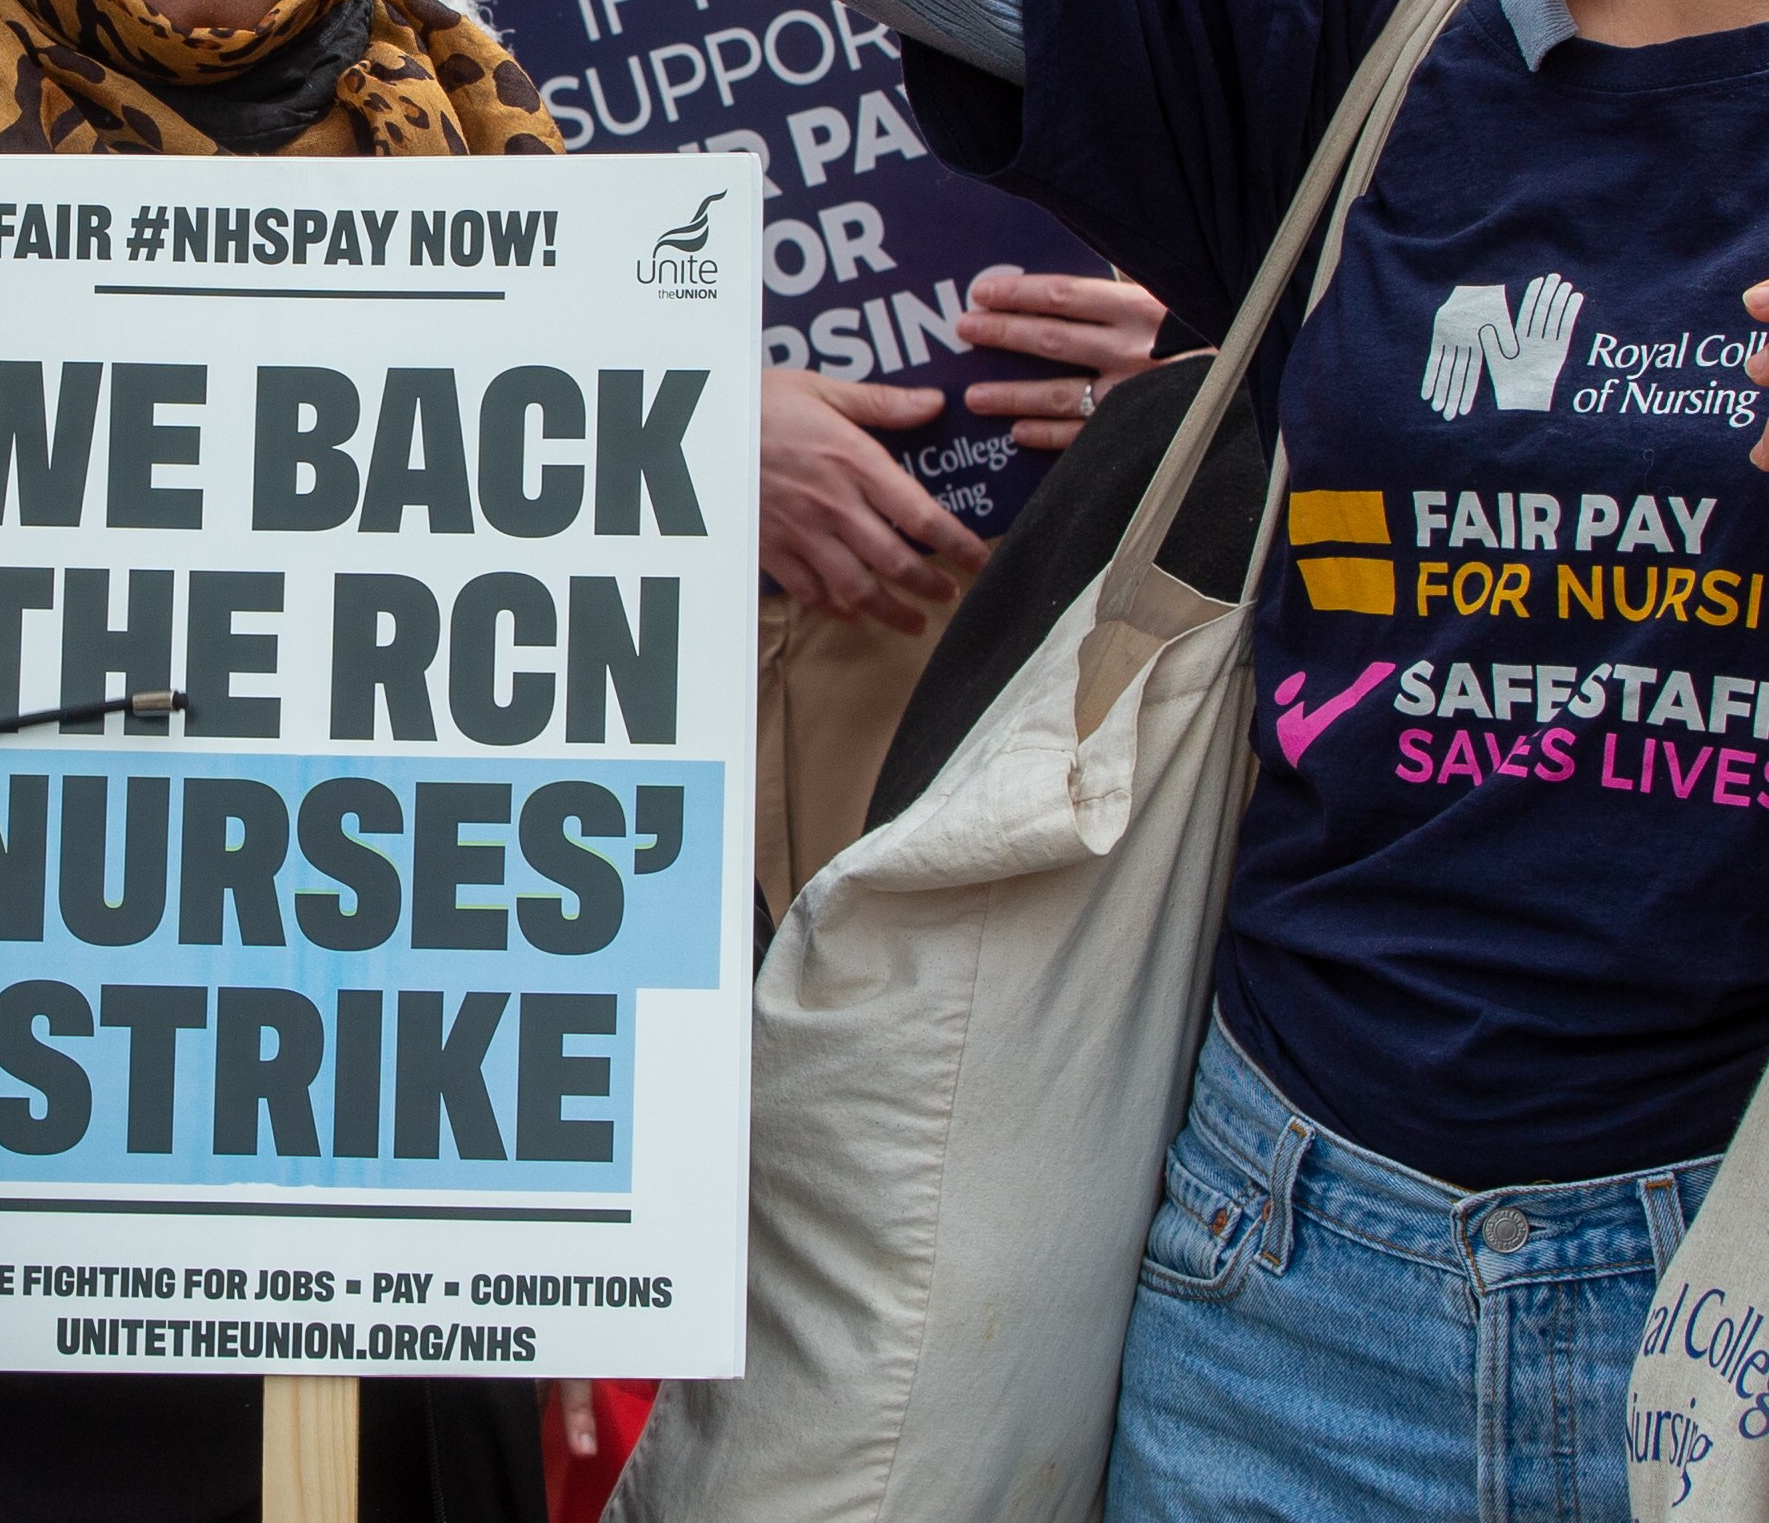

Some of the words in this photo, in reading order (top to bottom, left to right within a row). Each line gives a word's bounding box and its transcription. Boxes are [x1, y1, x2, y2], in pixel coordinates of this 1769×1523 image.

[786, 83, 928, 187] PA
[126, 205, 398, 268] #NHSPAY
[411, 210, 558, 268] NOW!
[1587, 332, 1690, 380] Royal
[1573, 379, 1619, 413] of
[1619, 380, 1760, 428] Nursing
[251, 364, 710, 539] BACK
[918, 434, 1018, 476] College
[1413, 491, 1561, 550] FAIR
[1575, 494, 1717, 554] PAY
[1416, 561, 1530, 618] FOR
[1557, 564, 1764, 629] NURSI
[330, 571, 681, 746] RCN
[1395, 727, 1576, 787] SAVES
[23, 1264, 177, 1301] FIGHTING
[183, 1267, 248, 1302] FOR
[254, 1268, 335, 1303] JOBS
[372, 1272, 433, 1305] PAY
[470, 1273, 674, 1310] CONDITIONS
[56, 1317, 538, 1363] UNITETHEUNION.ORG/NHS
